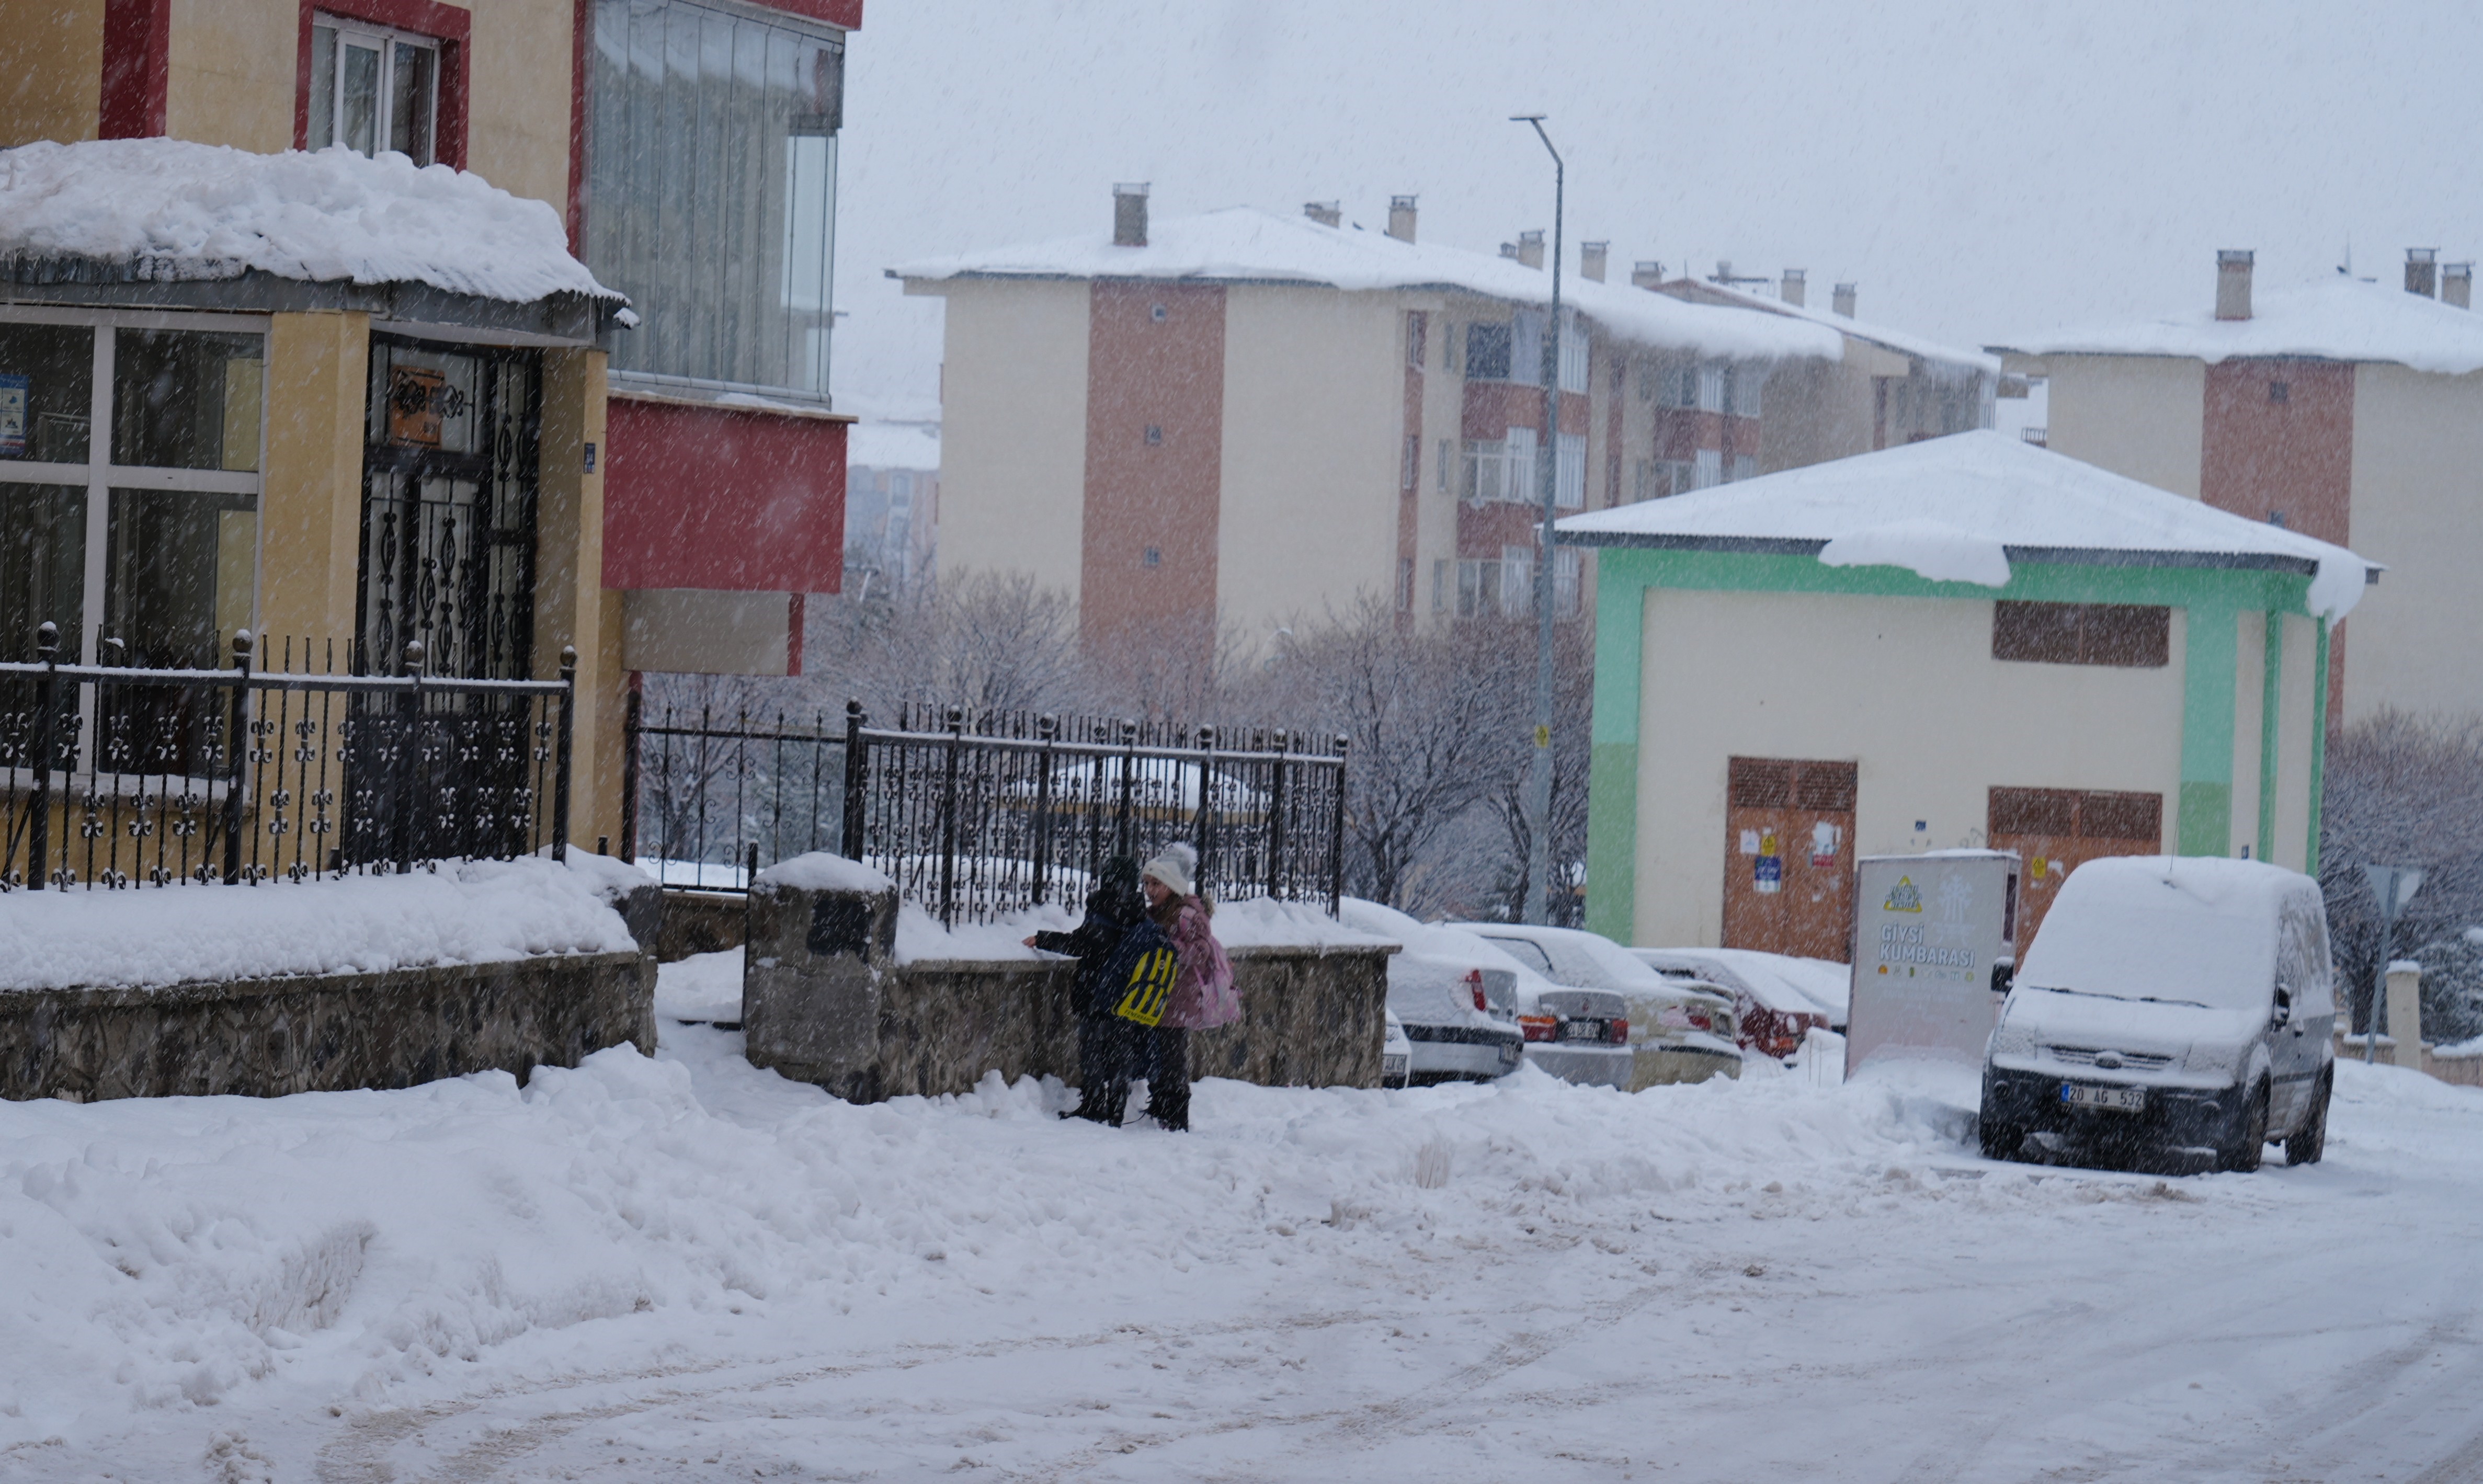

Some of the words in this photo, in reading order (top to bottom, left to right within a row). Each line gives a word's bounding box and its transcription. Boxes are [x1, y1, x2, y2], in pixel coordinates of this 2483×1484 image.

[1881, 921, 1924, 944] GİYSİ
[1880, 943, 1975, 967] KUMBARASI
[2069, 1087, 2085, 1101] 20
[2093, 1089, 2109, 1104] AG
[2120, 1091, 2143, 1107] 532
